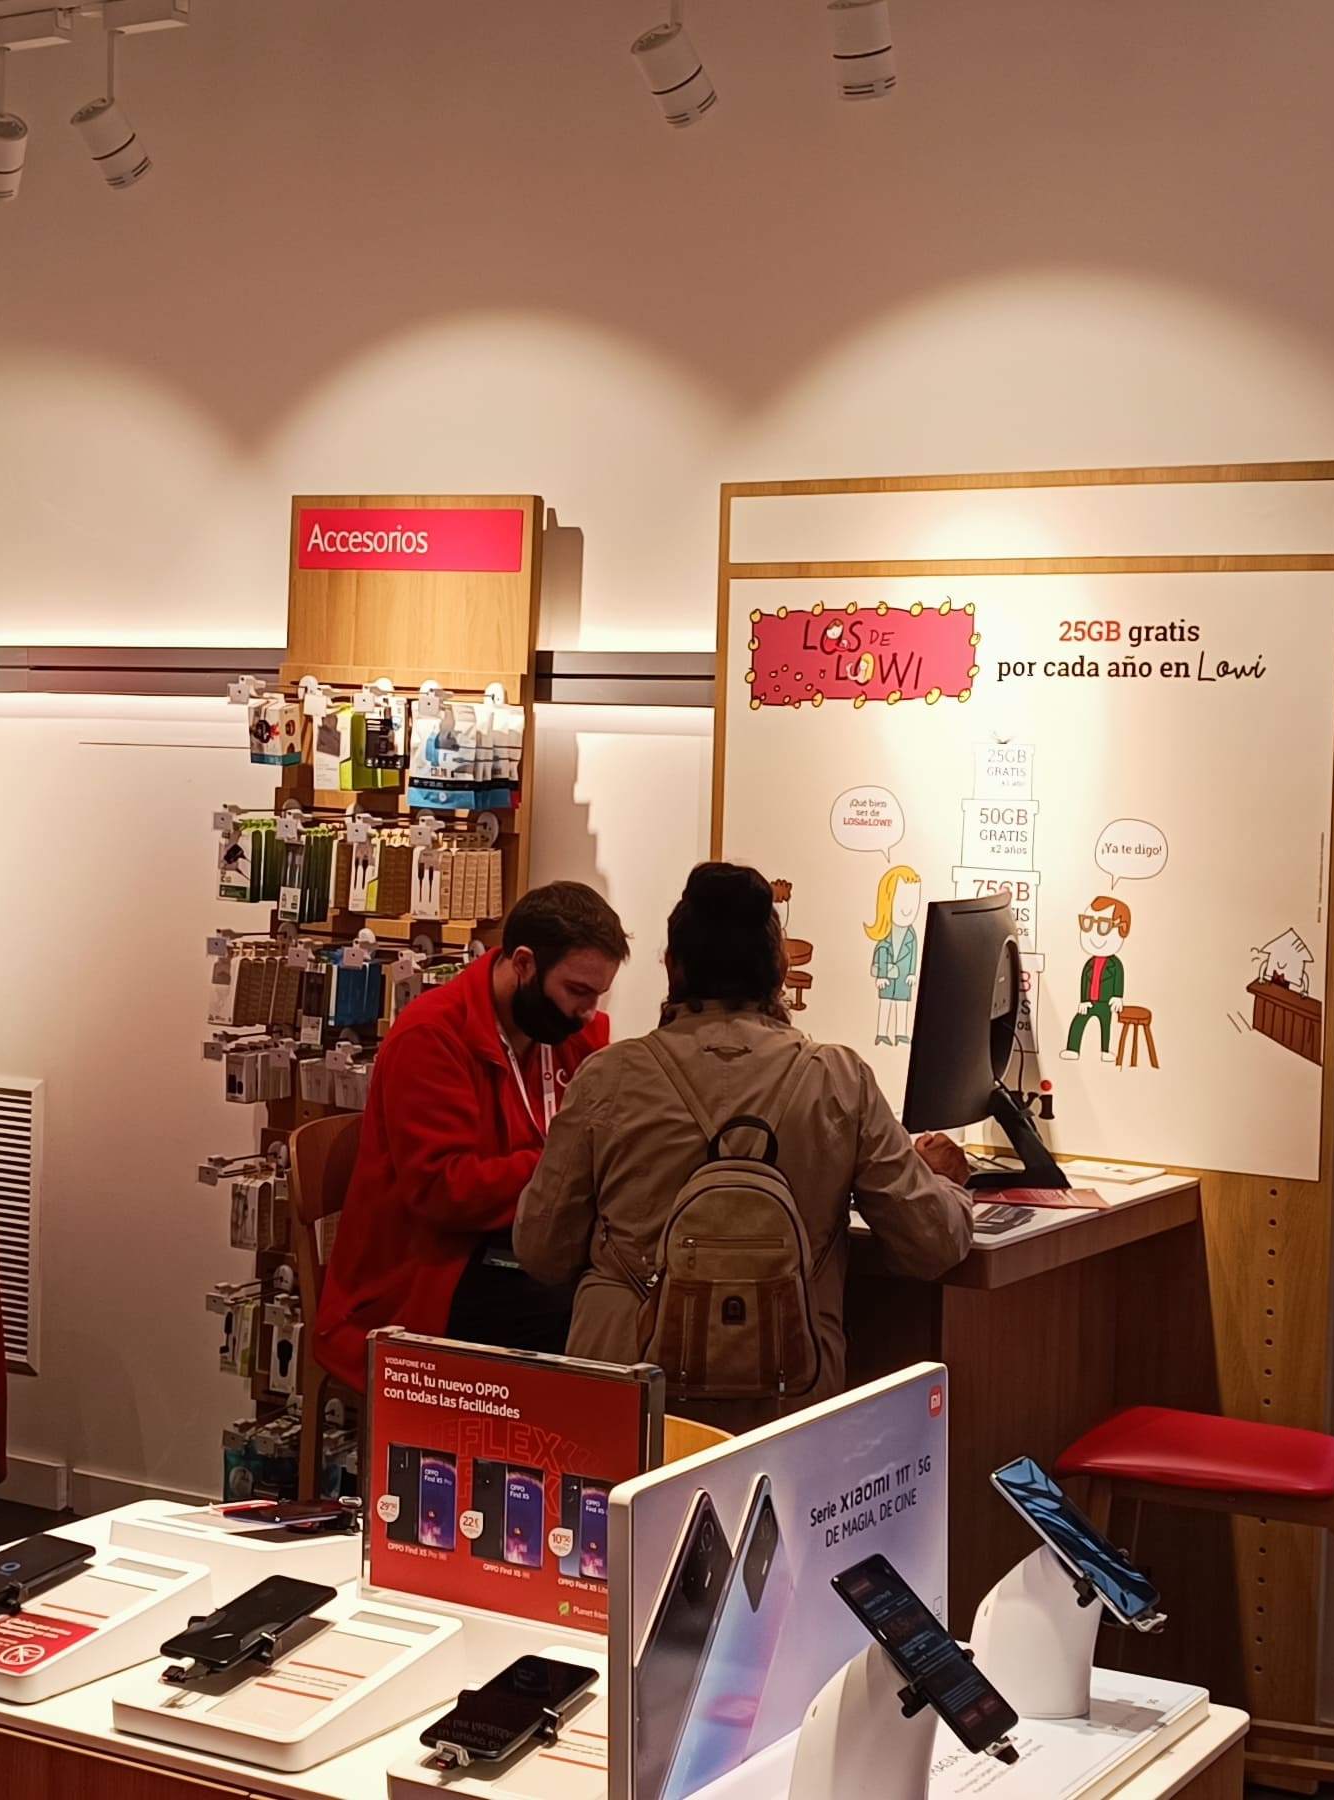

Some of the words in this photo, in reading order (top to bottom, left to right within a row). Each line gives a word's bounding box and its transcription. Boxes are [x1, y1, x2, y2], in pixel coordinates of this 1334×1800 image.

[307, 523, 429, 553] Accesorios
[869, 629, 895, 646] DE
[1059, 620, 1121, 642] 25GB
[1128, 619, 1200, 647] gratis
[997, 660, 1036, 681] por
[1043, 655, 1100, 678] cada
[1107, 656, 1152, 678] año
[1160, 660, 1191, 678] en
[1197, 650, 1267, 682] Lowi
[987, 766, 1027, 777] GRATIS
[979, 807, 1028, 826] 50GB
[979, 829, 1028, 842] GRATIS
[1121, 844, 1132, 855] te
[384, 1367, 409, 1384] Para
[411, 1372, 422, 1387] ti,
[424, 1375, 436, 1388] tu
[438, 1378, 474, 1394] nuevo
[475, 1382, 510, 1400] OPPO
[383, 1387, 405, 1400] con
[406, 1390, 438, 1406] todas
[439, 1394, 457, 1409] las
[458, 1397, 521, 1419] facilidades
[810, 1501, 837, 1528] Serie
[895, 1464, 911, 1487] 11T
[917, 1455, 932, 1477] 5G
[825, 1525, 840, 1548] DE
[842, 1509, 878, 1540] MAGIA,
[879, 1498, 893, 1522] DE
[894, 1487, 917, 1513] CINE
